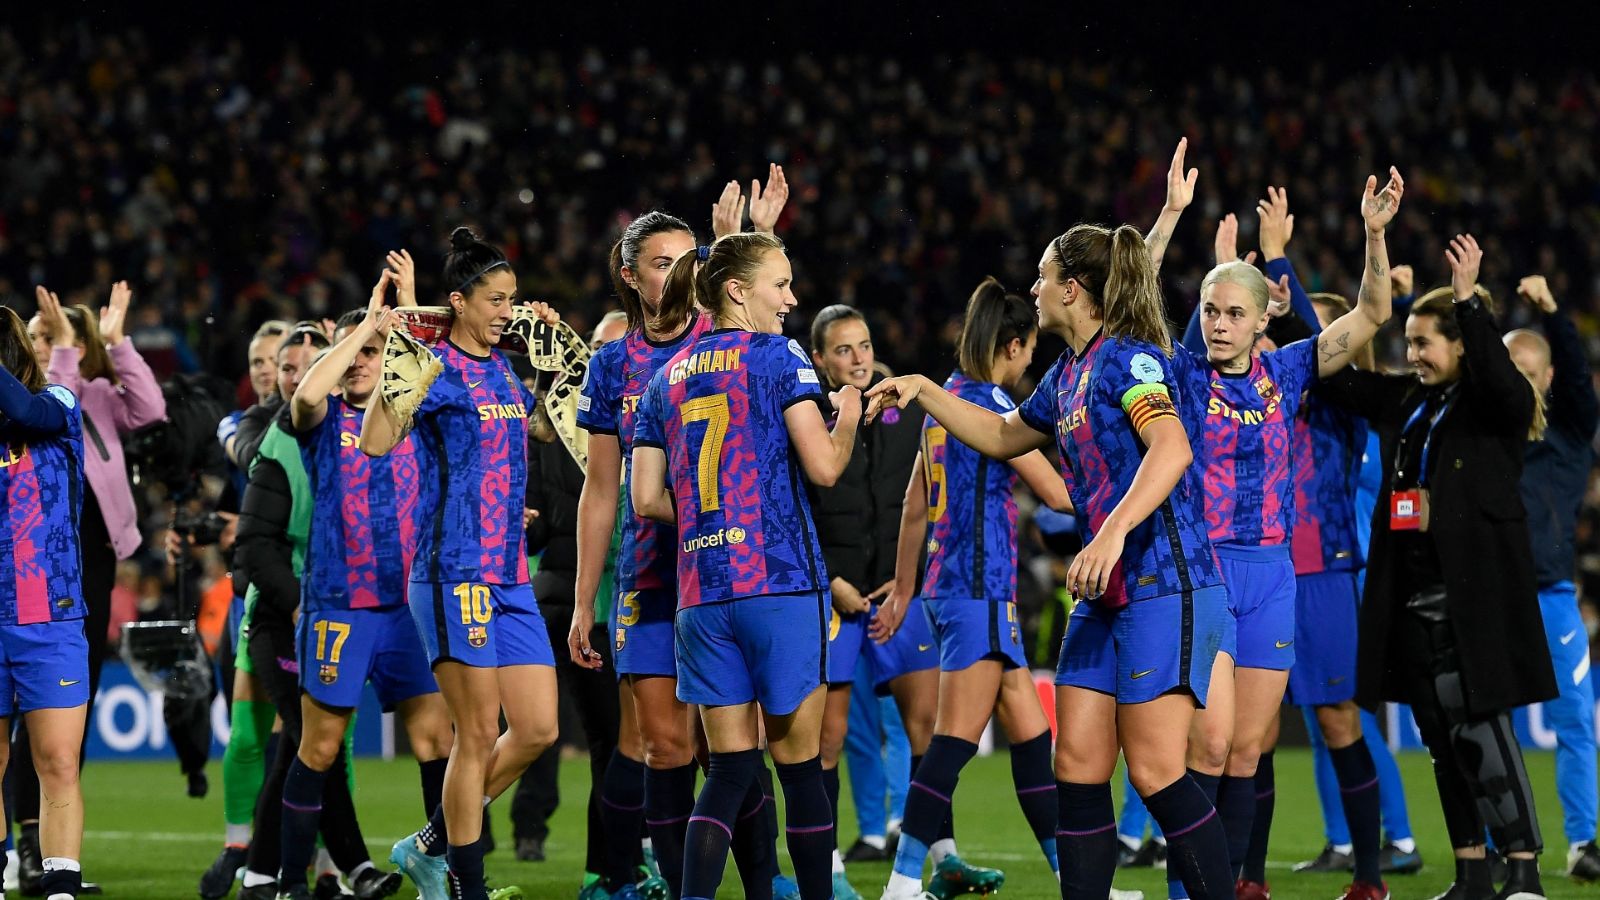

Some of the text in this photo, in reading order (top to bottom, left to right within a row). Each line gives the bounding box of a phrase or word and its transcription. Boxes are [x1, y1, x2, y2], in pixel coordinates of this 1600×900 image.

[669, 349, 740, 385] GRAHAM
[679, 393, 731, 513] 7
[683, 528, 724, 552] unicef
[453, 582, 493, 625] 10
[313, 619, 351, 663] 17
